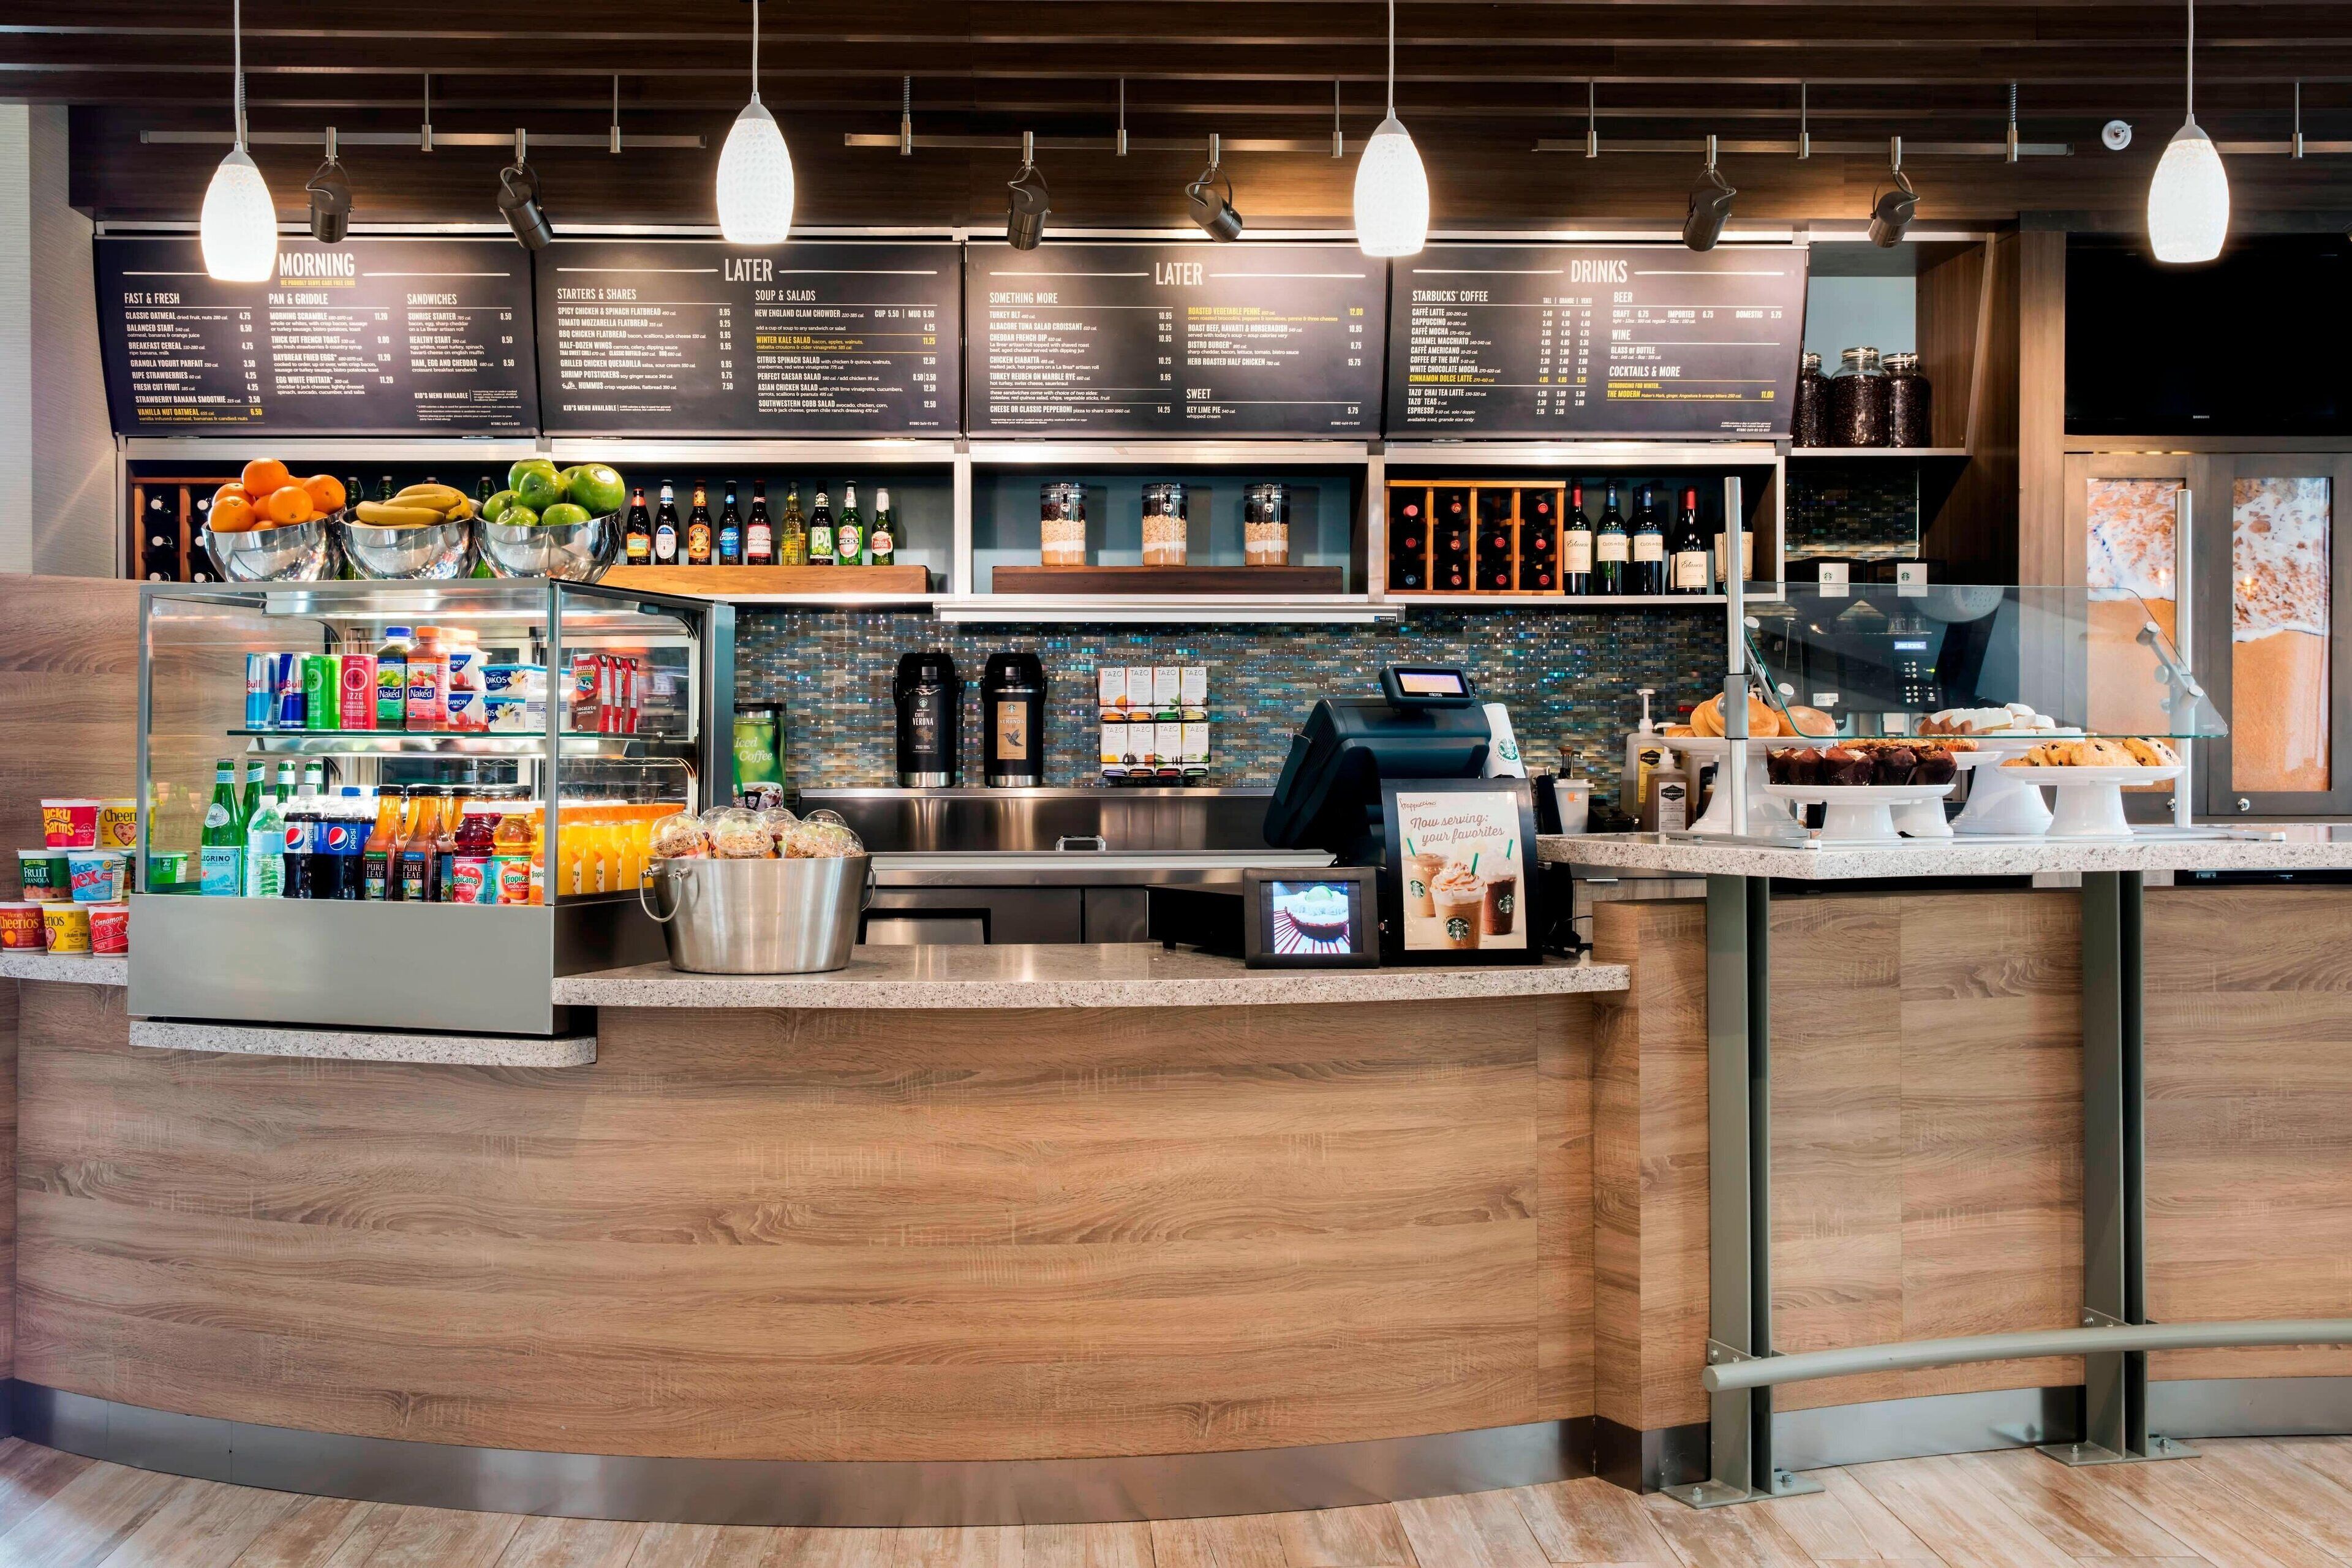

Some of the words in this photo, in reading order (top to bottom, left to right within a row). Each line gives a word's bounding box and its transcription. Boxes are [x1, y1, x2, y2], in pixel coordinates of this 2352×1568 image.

[279, 252, 355, 277] MORNING
[725, 258, 773, 282] LATER
[1156, 262, 1203, 285] LATER
[1571, 260, 1628, 283] DRINKS
[124, 293, 143, 304] FAST
[146, 293, 152, 304] &
[154, 293, 179, 304] FRESH
[268, 293, 284, 305] PAN
[287, 293, 293, 304] &
[295, 293, 328, 305] GRIDDLE
[407, 293, 457, 305] SANDWICHES
[557, 288, 596, 300] STARTERS
[598, 289, 604, 300] &
[606, 288, 636, 300] SHARES
[755, 290, 775, 301] SOUP
[778, 290, 783, 301] &
[786, 290, 816, 301] SALADS
[990, 292, 1033, 304] SOMETHING
[1036, 292, 1058, 304] MORE
[1460, 291, 1488, 302] COFFEE
[1614, 292, 1633, 303] BEER
[239, 312, 251, 320] 4.75
[719, 308, 730, 317] 9.95
[769, 309, 794, 318] ENGLAND
[796, 309, 812, 318] CLAM
[813, 309, 840, 318] CHOWDER
[1612, 330, 1631, 341] WINE
[242, 342, 254, 350] 4.75
[1609, 366, 1649, 377] COCKTAILS
[1651, 366, 1657, 377] &
[1659, 366, 1681, 377] MORE
[1186, 388, 1211, 399] SWEET
[812, 532, 832, 549] IPA
[734, 737, 758, 748] Iced
[739, 750, 773, 763] Coffee
[1411, 816, 1439, 830] Now
[1441, 813, 1489, 827] serving:
[1422, 831, 1450, 846] your
[1452, 826, 1505, 843] favorites
[24, 867, 49, 877] FRUIT
[95, 916, 123, 926] Cinnamon
